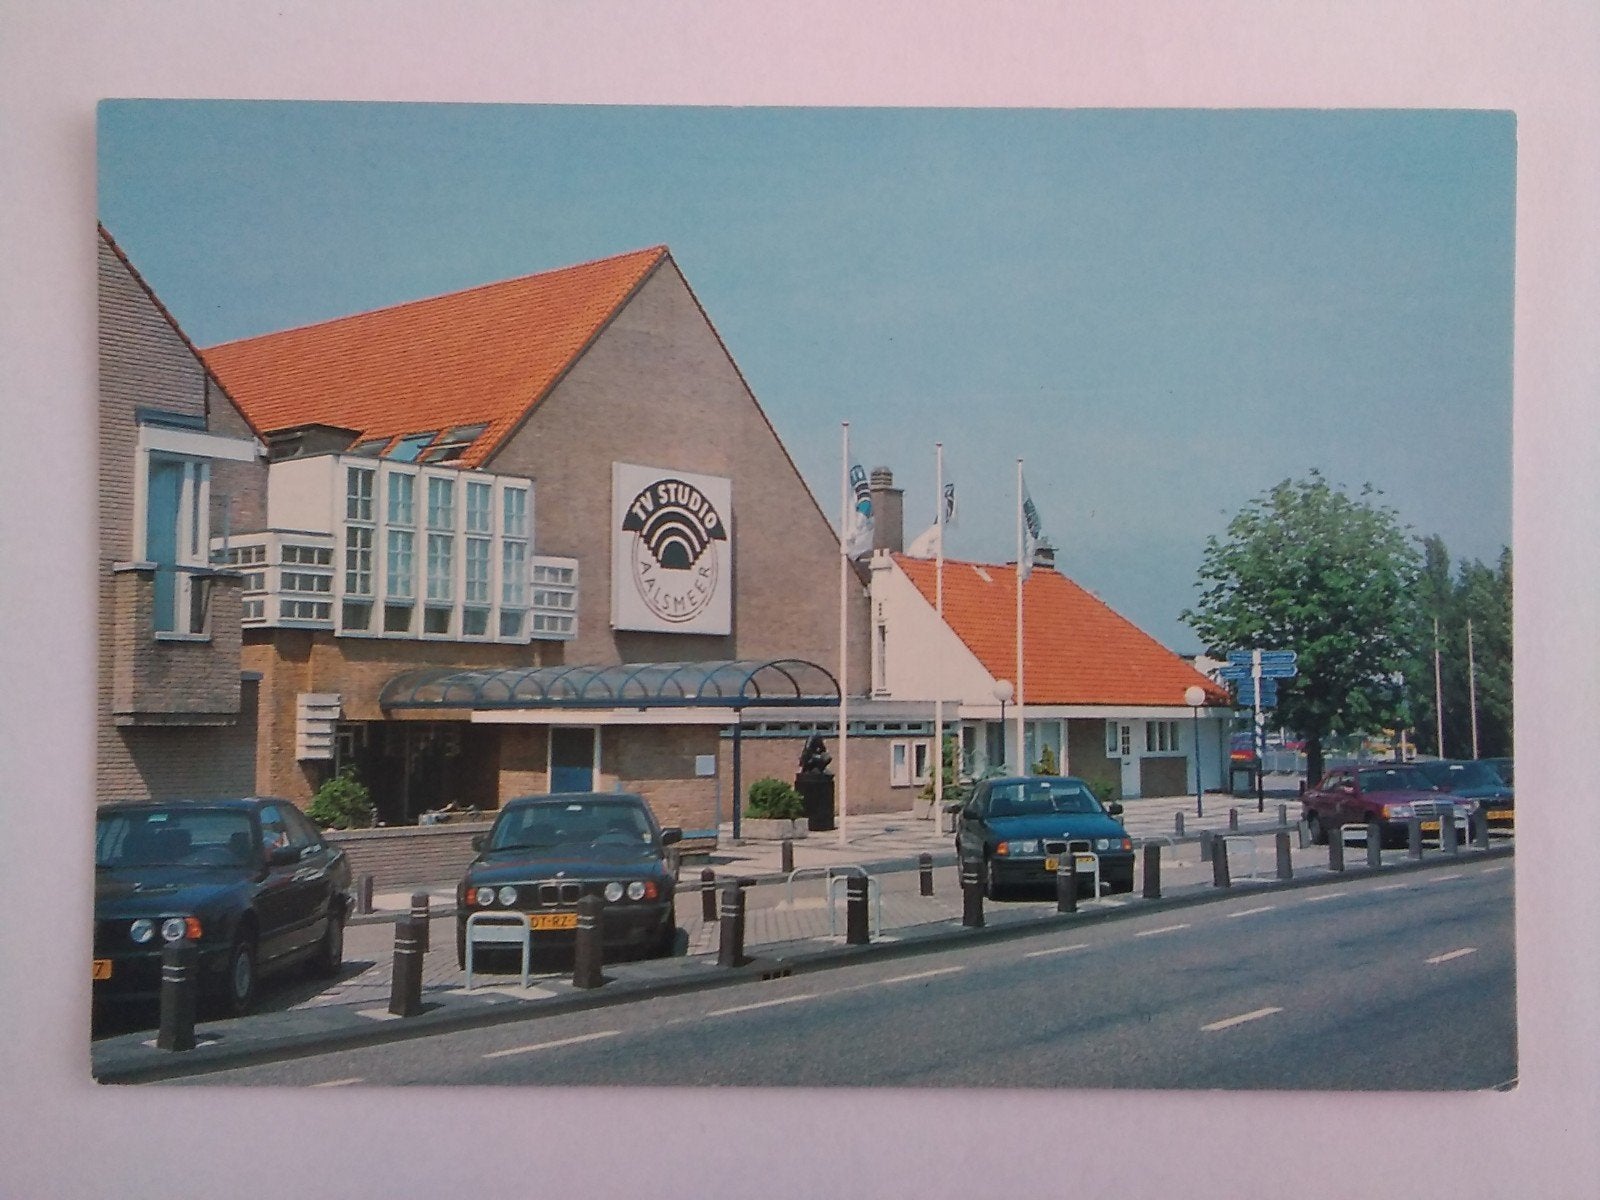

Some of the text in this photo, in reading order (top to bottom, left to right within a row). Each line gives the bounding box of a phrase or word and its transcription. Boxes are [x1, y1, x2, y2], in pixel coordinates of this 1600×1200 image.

[632, 483, 717, 529] TV STUDIO
[640, 561, 711, 613] AALSMEER
